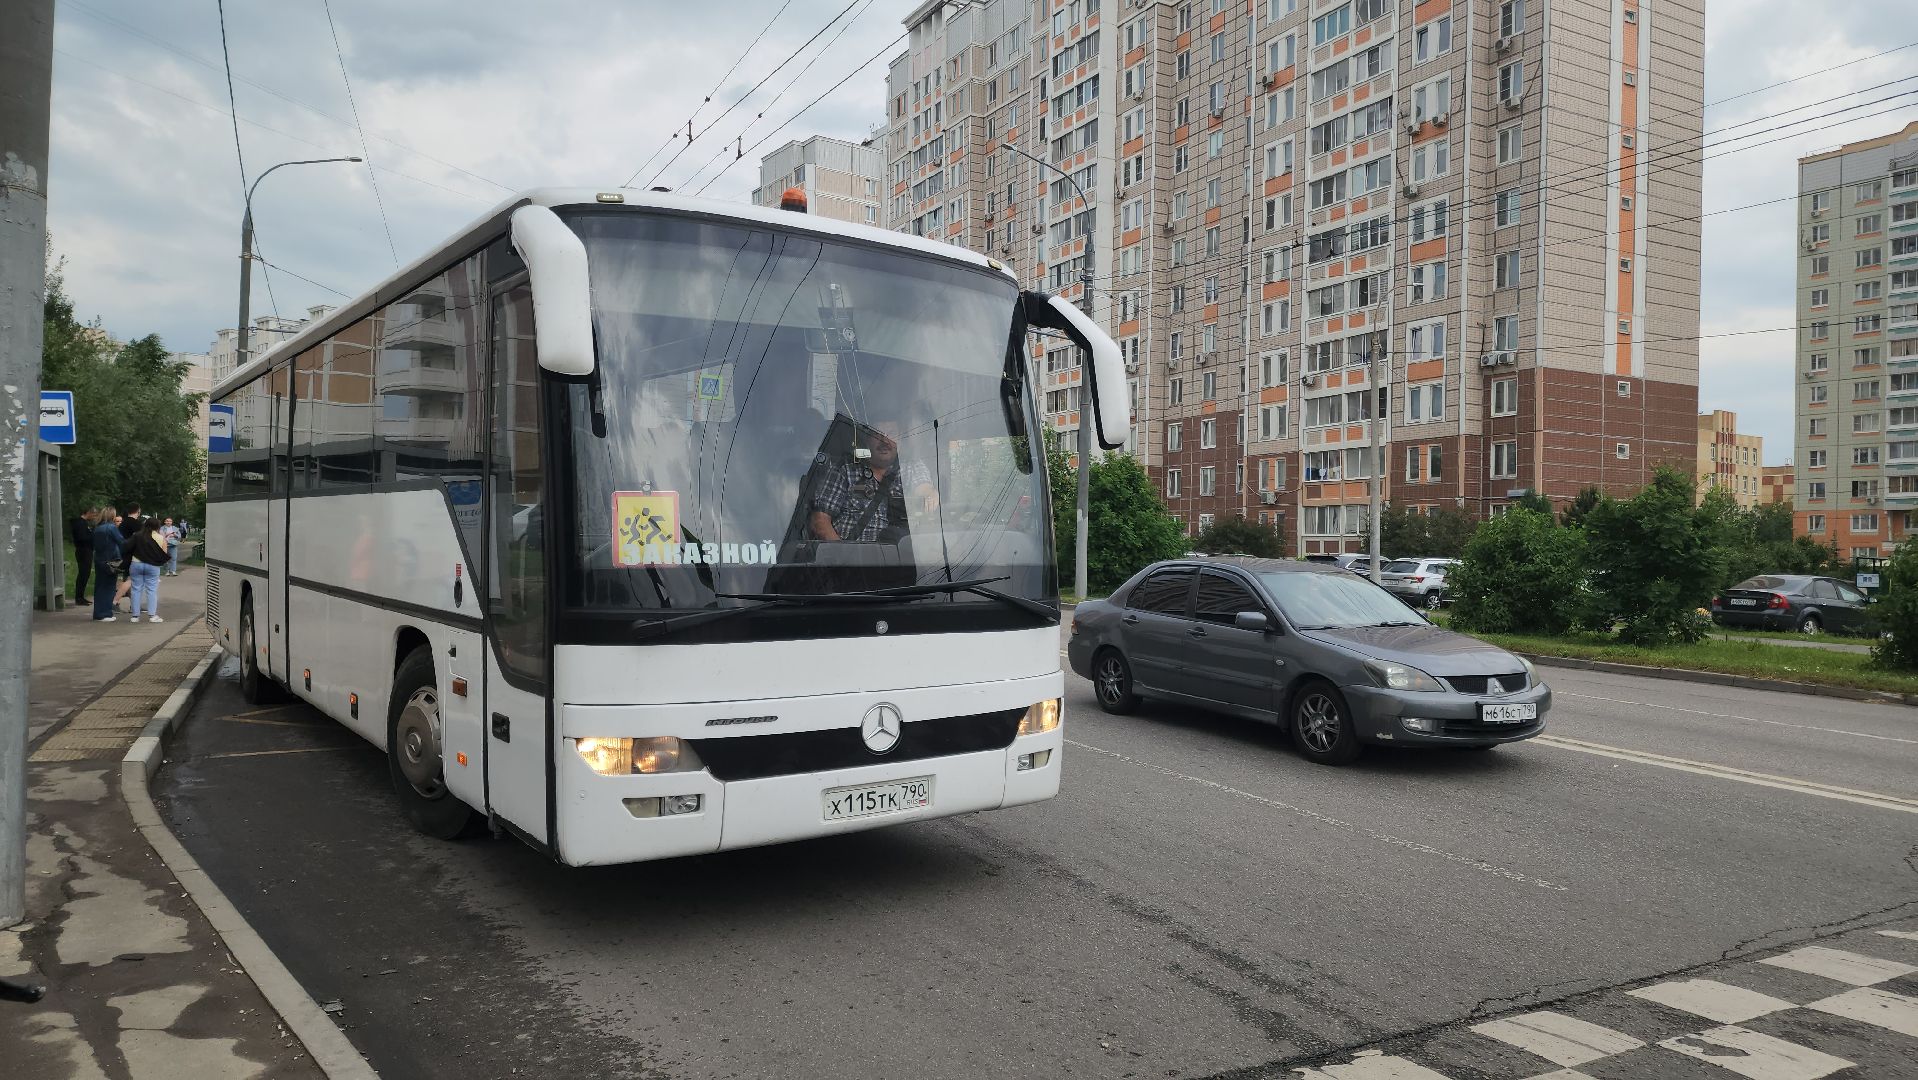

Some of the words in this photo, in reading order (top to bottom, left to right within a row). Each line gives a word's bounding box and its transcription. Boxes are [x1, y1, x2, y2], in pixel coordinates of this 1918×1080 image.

[622, 539, 777, 566] ЗАКАЗНОЙ
[831, 790, 898, 815] Х115ТК
[901, 783, 926, 800] 790
